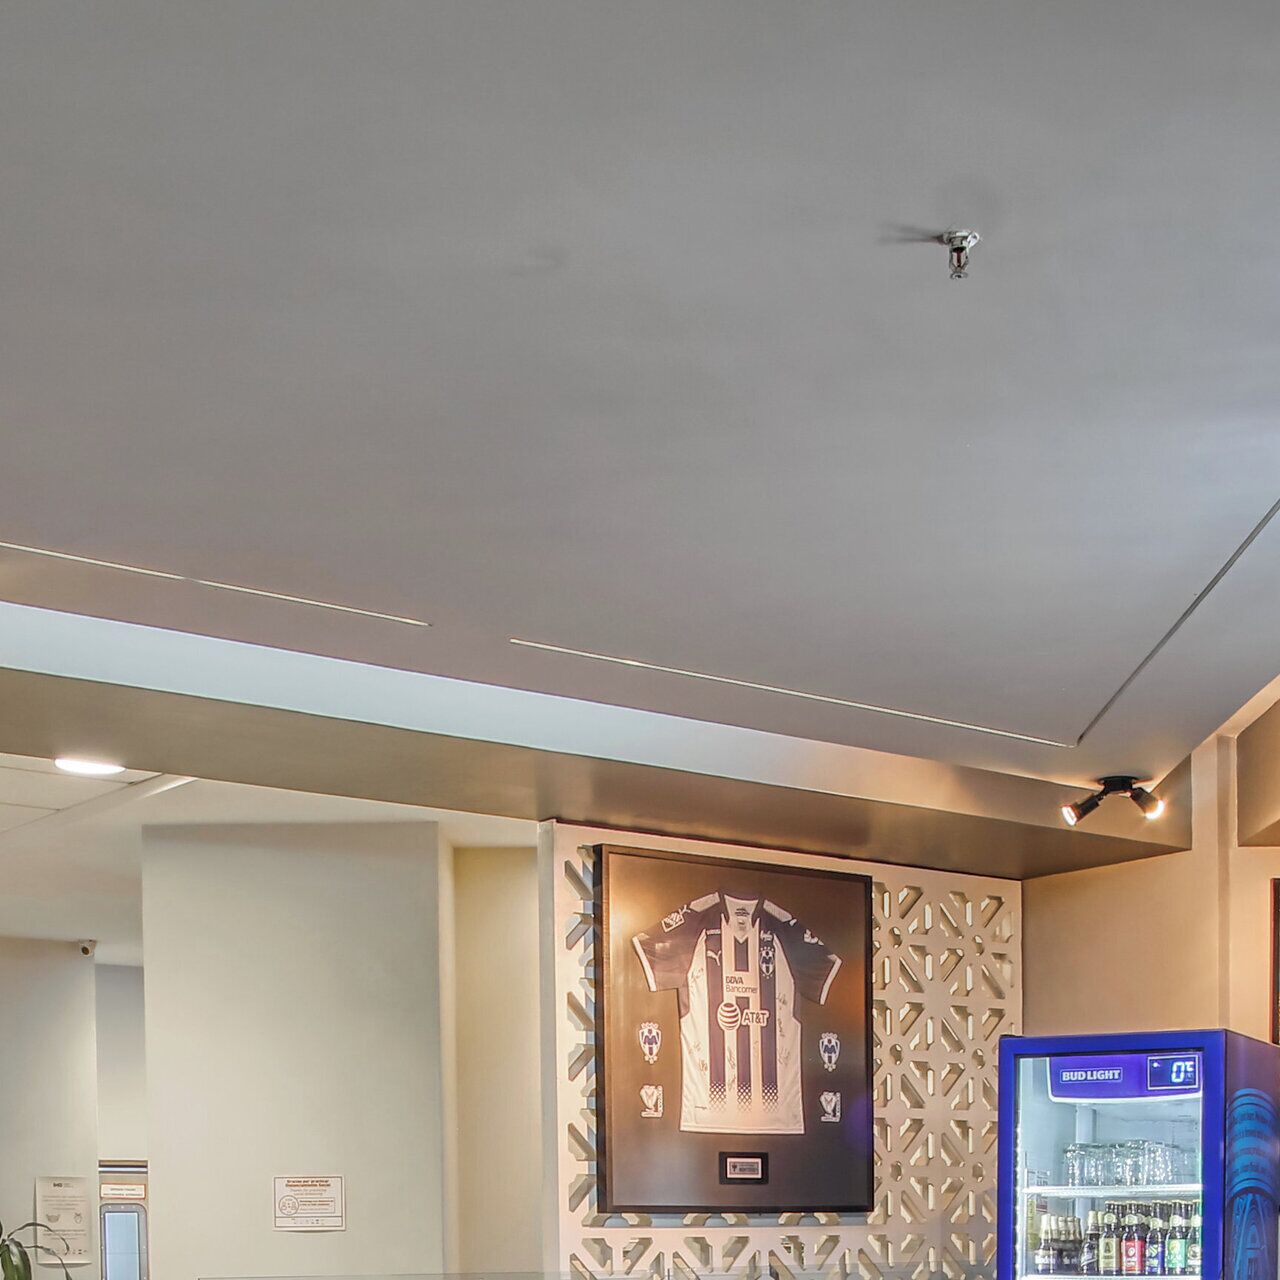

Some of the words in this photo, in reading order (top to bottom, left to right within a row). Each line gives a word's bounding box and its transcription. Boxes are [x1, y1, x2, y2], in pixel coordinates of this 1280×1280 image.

[743, 1011, 768, 1024] AT&T
[1062, 1071, 1087, 1081] BUD
[1087, 1069, 1121, 1081] LIGHT
